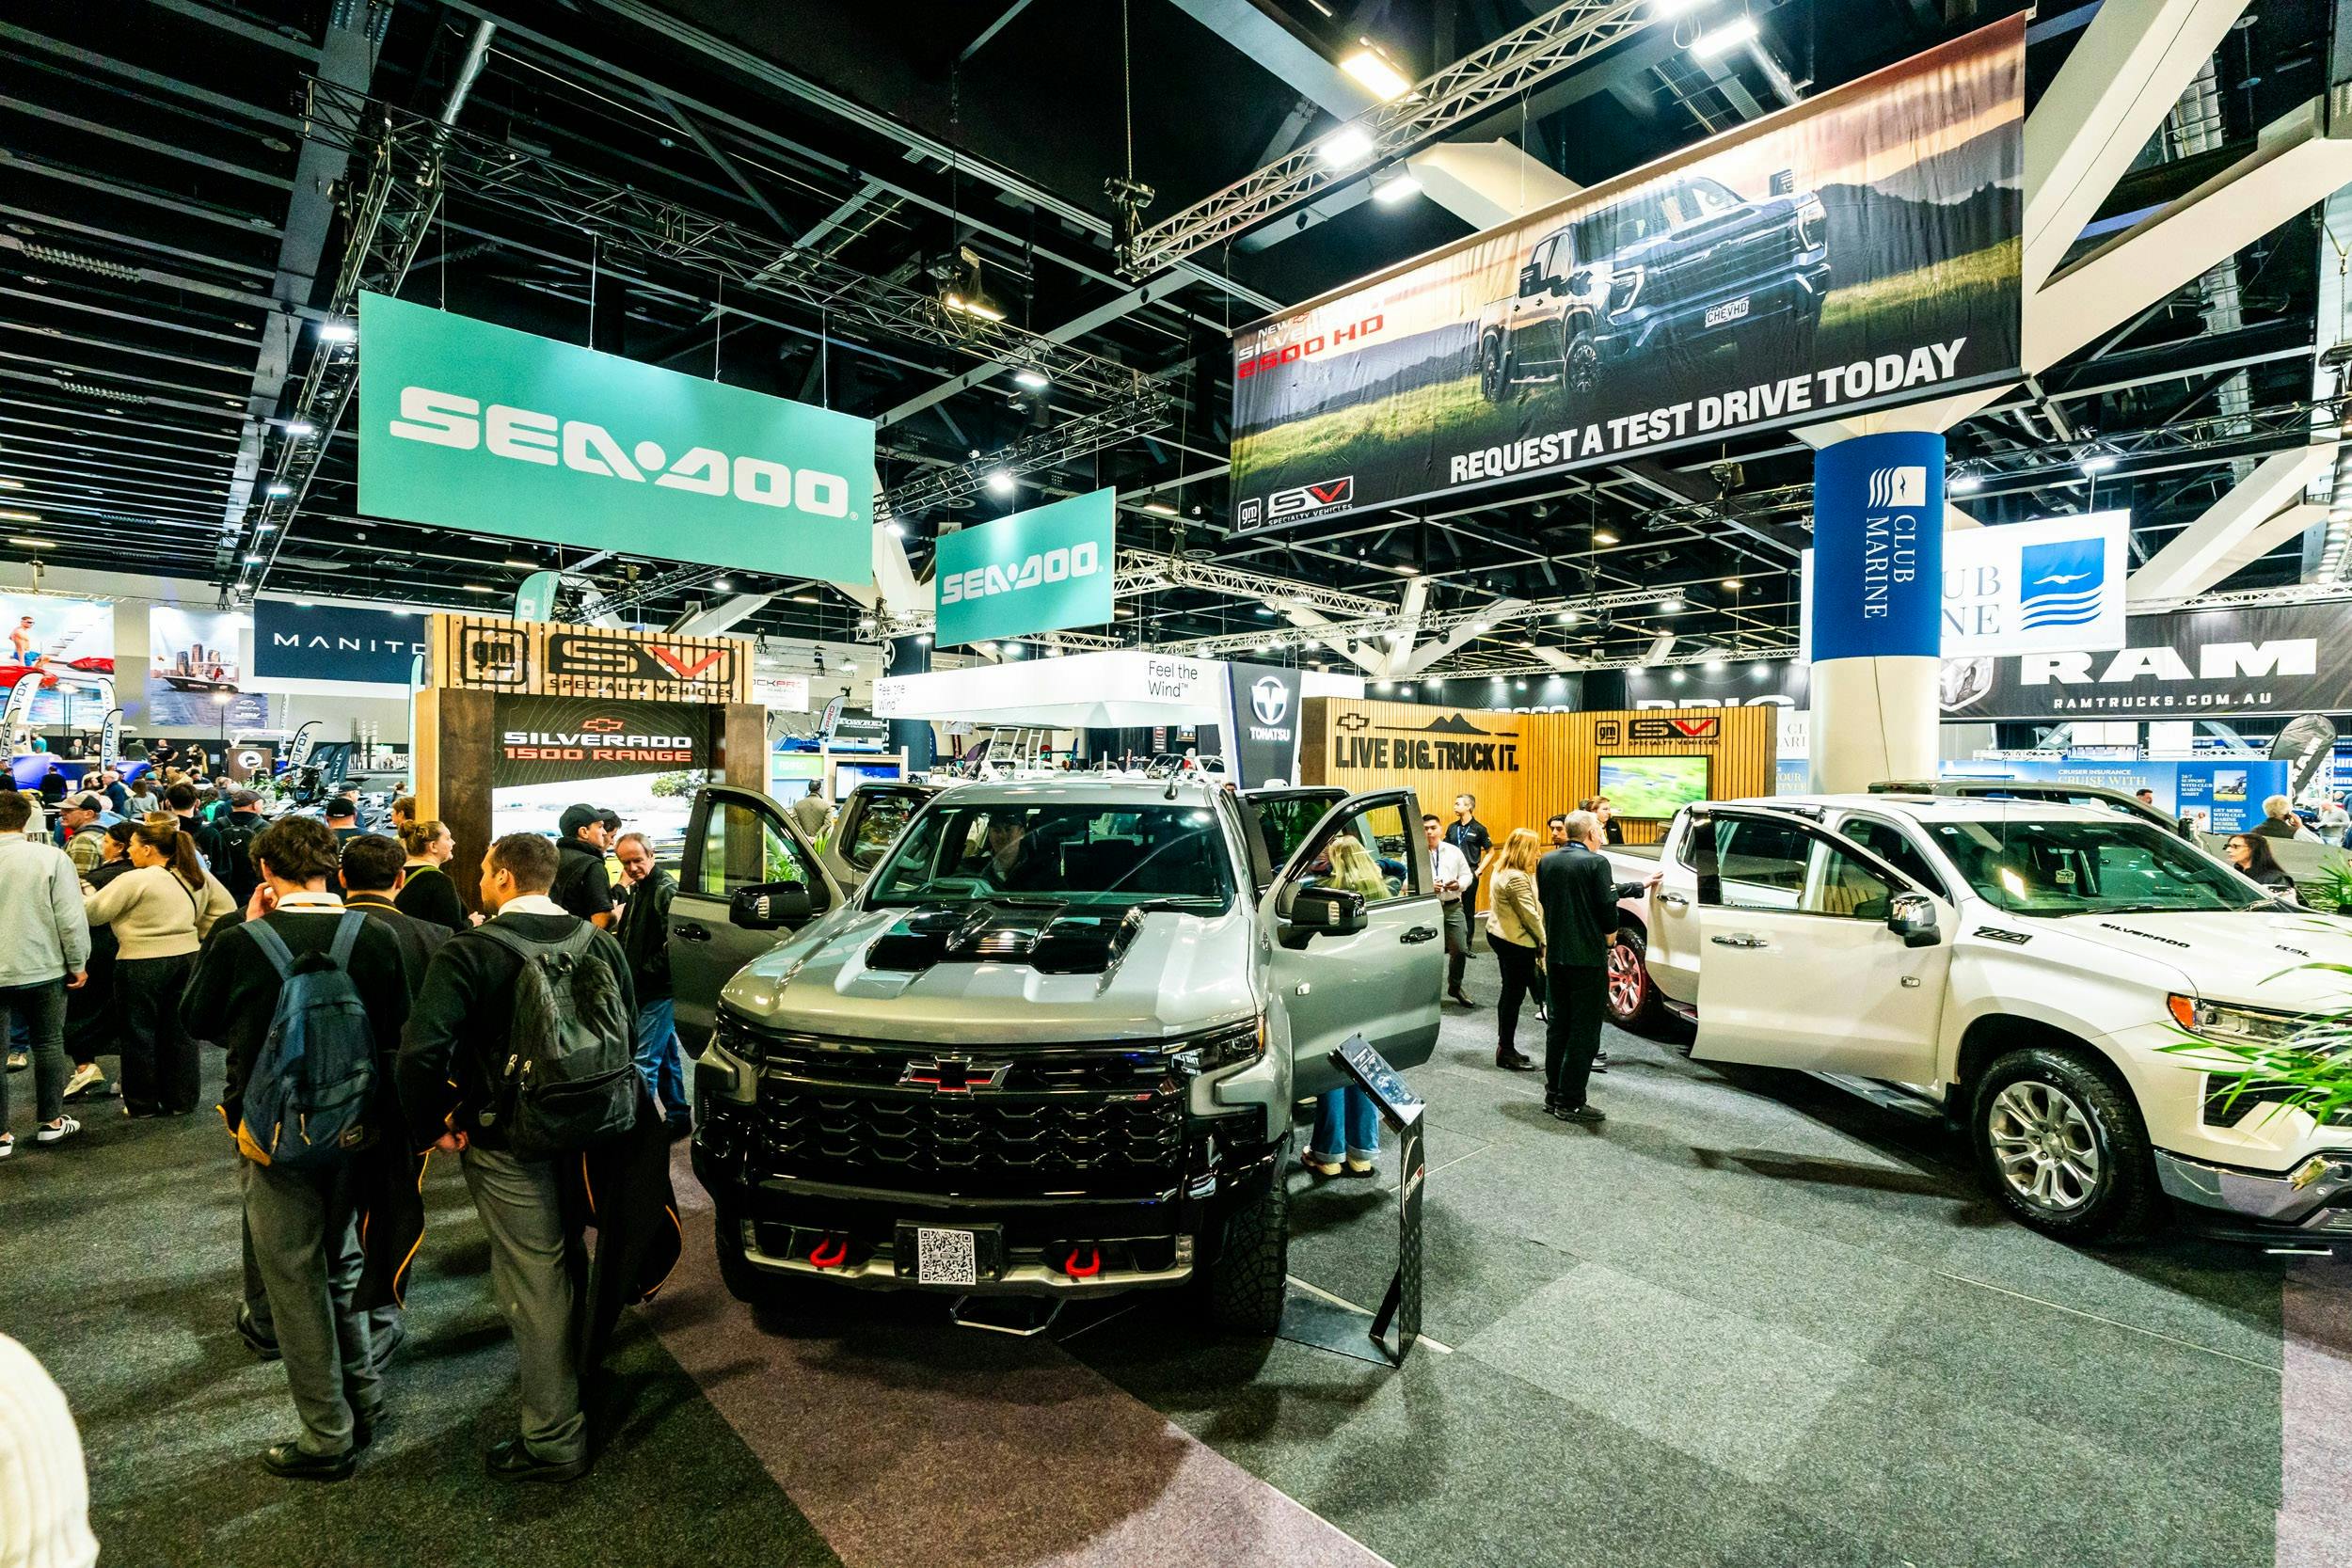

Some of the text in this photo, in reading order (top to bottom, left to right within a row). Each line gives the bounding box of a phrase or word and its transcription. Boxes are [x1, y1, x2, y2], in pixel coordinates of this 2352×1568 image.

[1708, 302, 1747, 323] CHEVHD
[1258, 321, 1291, 339] NEW
[1237, 314, 1383, 380] 2500 HD
[1451, 337, 1967, 484] REQUEST A TEST DRIVE TODAY
[1268, 503, 1353, 526] SPECIALTY VEHICLES
[1893, 515, 1916, 583] CLUB
[1864, 515, 1890, 619] MARINE
[1942, 565, 2001, 599] UB
[274, 632, 426, 656] MANITO
[472, 641, 516, 671] gm
[2021, 638, 2317, 685] RAM
[1149, 660, 1198, 680] Feel the
[549, 679, 734, 699] SPECIALTY VEHICLES
[2053, 692, 2272, 709] RAMTRUCKS.COM.AU
[503, 732, 692, 749] SILVERADO
[1249, 727, 1290, 741] TOHATSU
[1599, 725, 1615, 739] gm
[503, 747, 692, 762] 1500 RANGE
[1335, 736, 1389, 768] LIVE
[1499, 745, 1519, 771] IT.
[2108, 776, 2147, 785] WITH
[2099, 923, 2190, 948] SILVERADO
